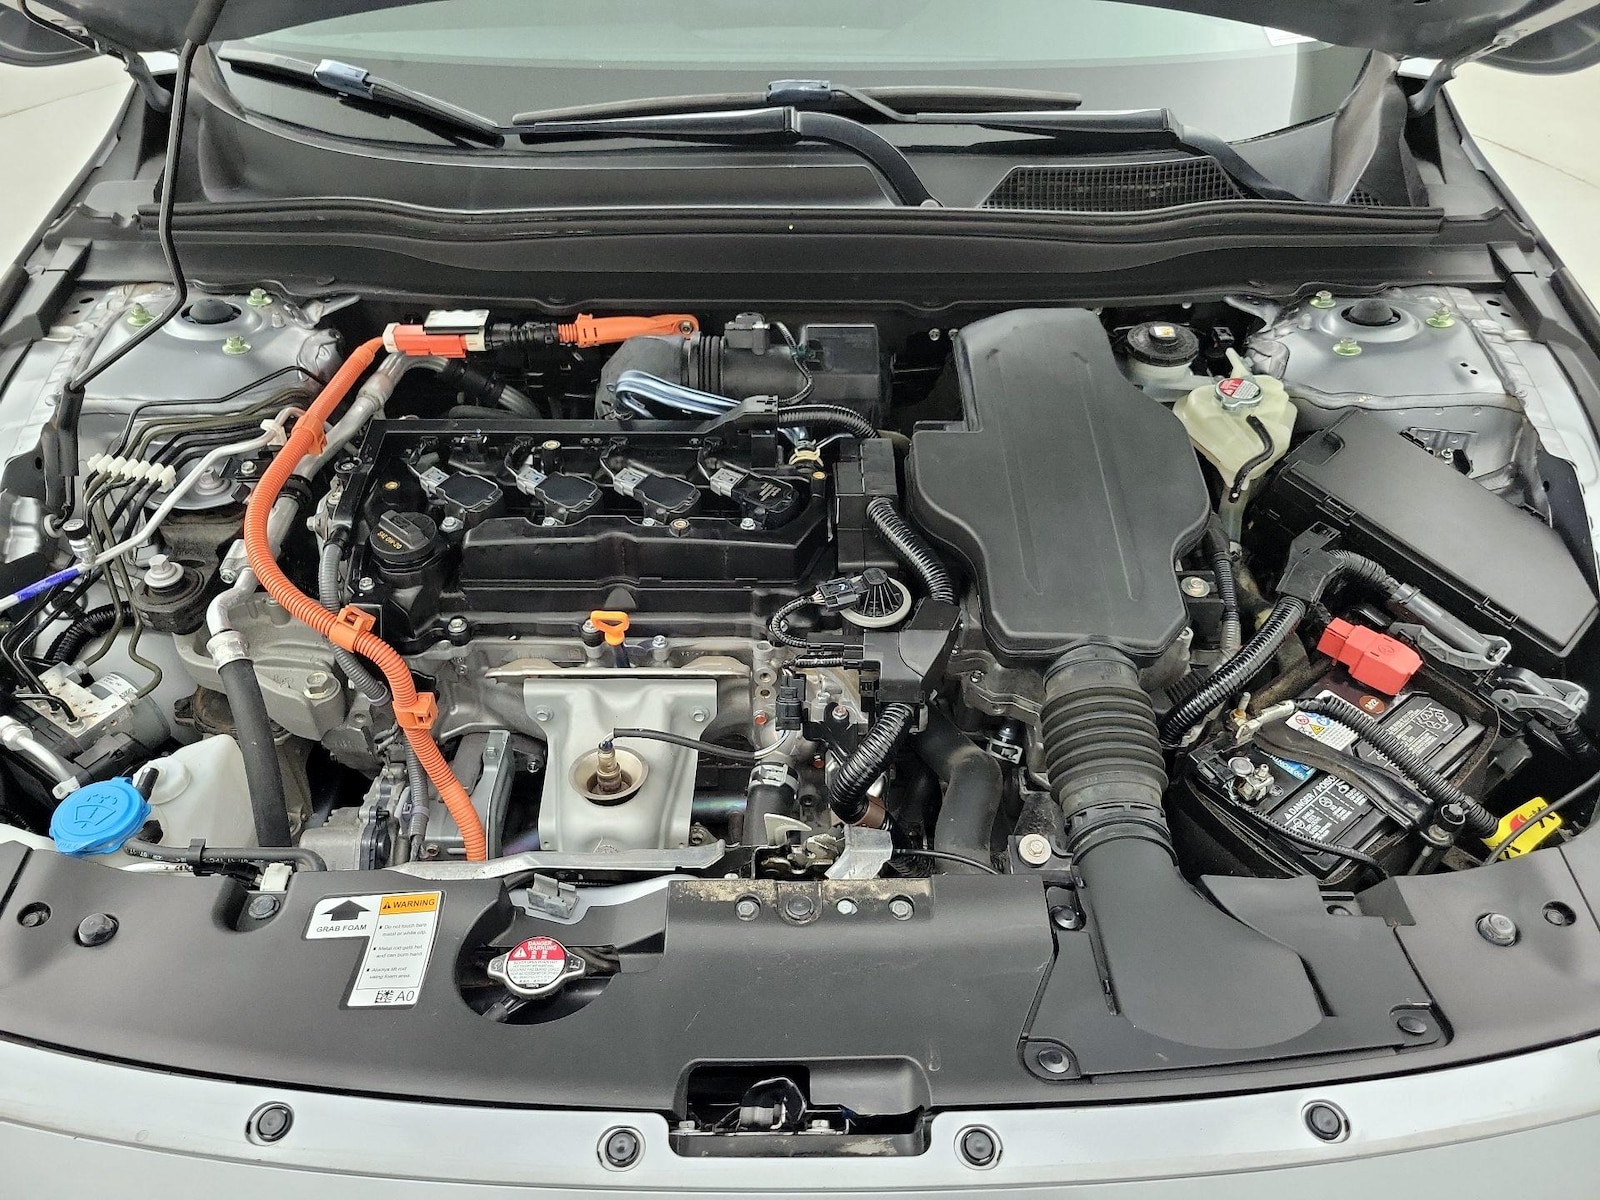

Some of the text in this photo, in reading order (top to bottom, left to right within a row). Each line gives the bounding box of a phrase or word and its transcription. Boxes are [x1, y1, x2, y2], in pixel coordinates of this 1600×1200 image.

[1288, 793, 1315, 815] DANGER
[1315, 775, 1337, 792] POISO
[393, 898, 435, 908] WARNING
[395, 990, 415, 1002] A0
